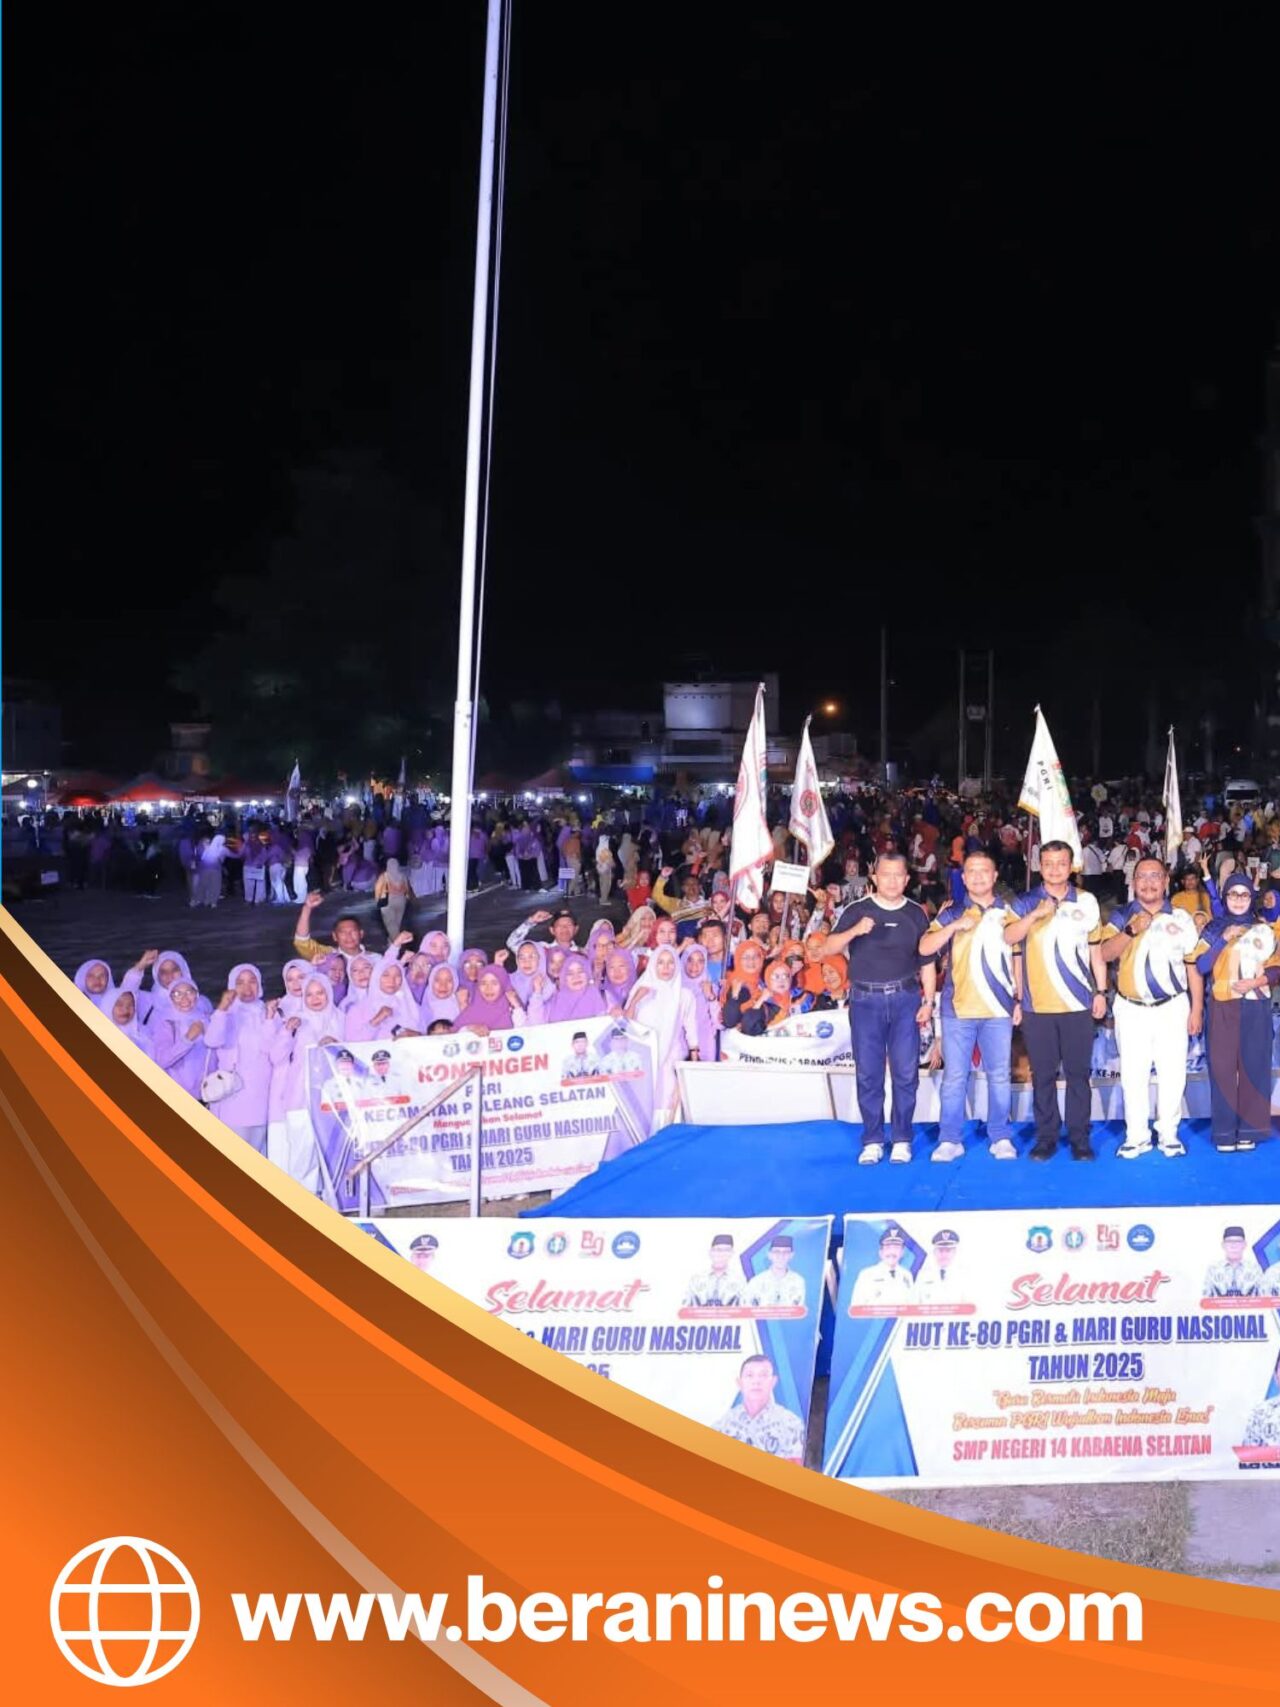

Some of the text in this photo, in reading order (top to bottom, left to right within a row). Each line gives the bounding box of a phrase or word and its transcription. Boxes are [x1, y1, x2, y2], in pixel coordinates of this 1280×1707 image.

[465, 1081, 502, 1098] PRI
[365, 1086, 606, 1124] KECAMTAN PLEANG SELATAN
[433, 1110, 543, 1129] Menguckan Selamat
[431, 1131, 464, 1152] PGRI
[480, 1127, 511, 1147] HARI
[513, 1122, 552, 1142] GURU
[554, 1115, 618, 1138] NASIONAL
[450, 1147, 535, 1172] TAUN 2025
[484, 1278, 651, 1316] Selamat
[1006, 1269, 1171, 1311] Selamat
[541, 1325, 589, 1354] HARI
[591, 1326, 647, 1353] GURU
[648, 1325, 742, 1352] NASIONAL
[904, 1314, 1268, 1349] HUT KE-80 PGRI & HARI GURU NASIONAL
[1028, 1352, 1145, 1382] TAHUN 2025
[1083, 1387, 1140, 1404] Indonesia
[1115, 1408, 1173, 1425] Indonesia
[952, 1434, 1212, 1462] SMP NEGERI 14 KABAENA SELATAN
